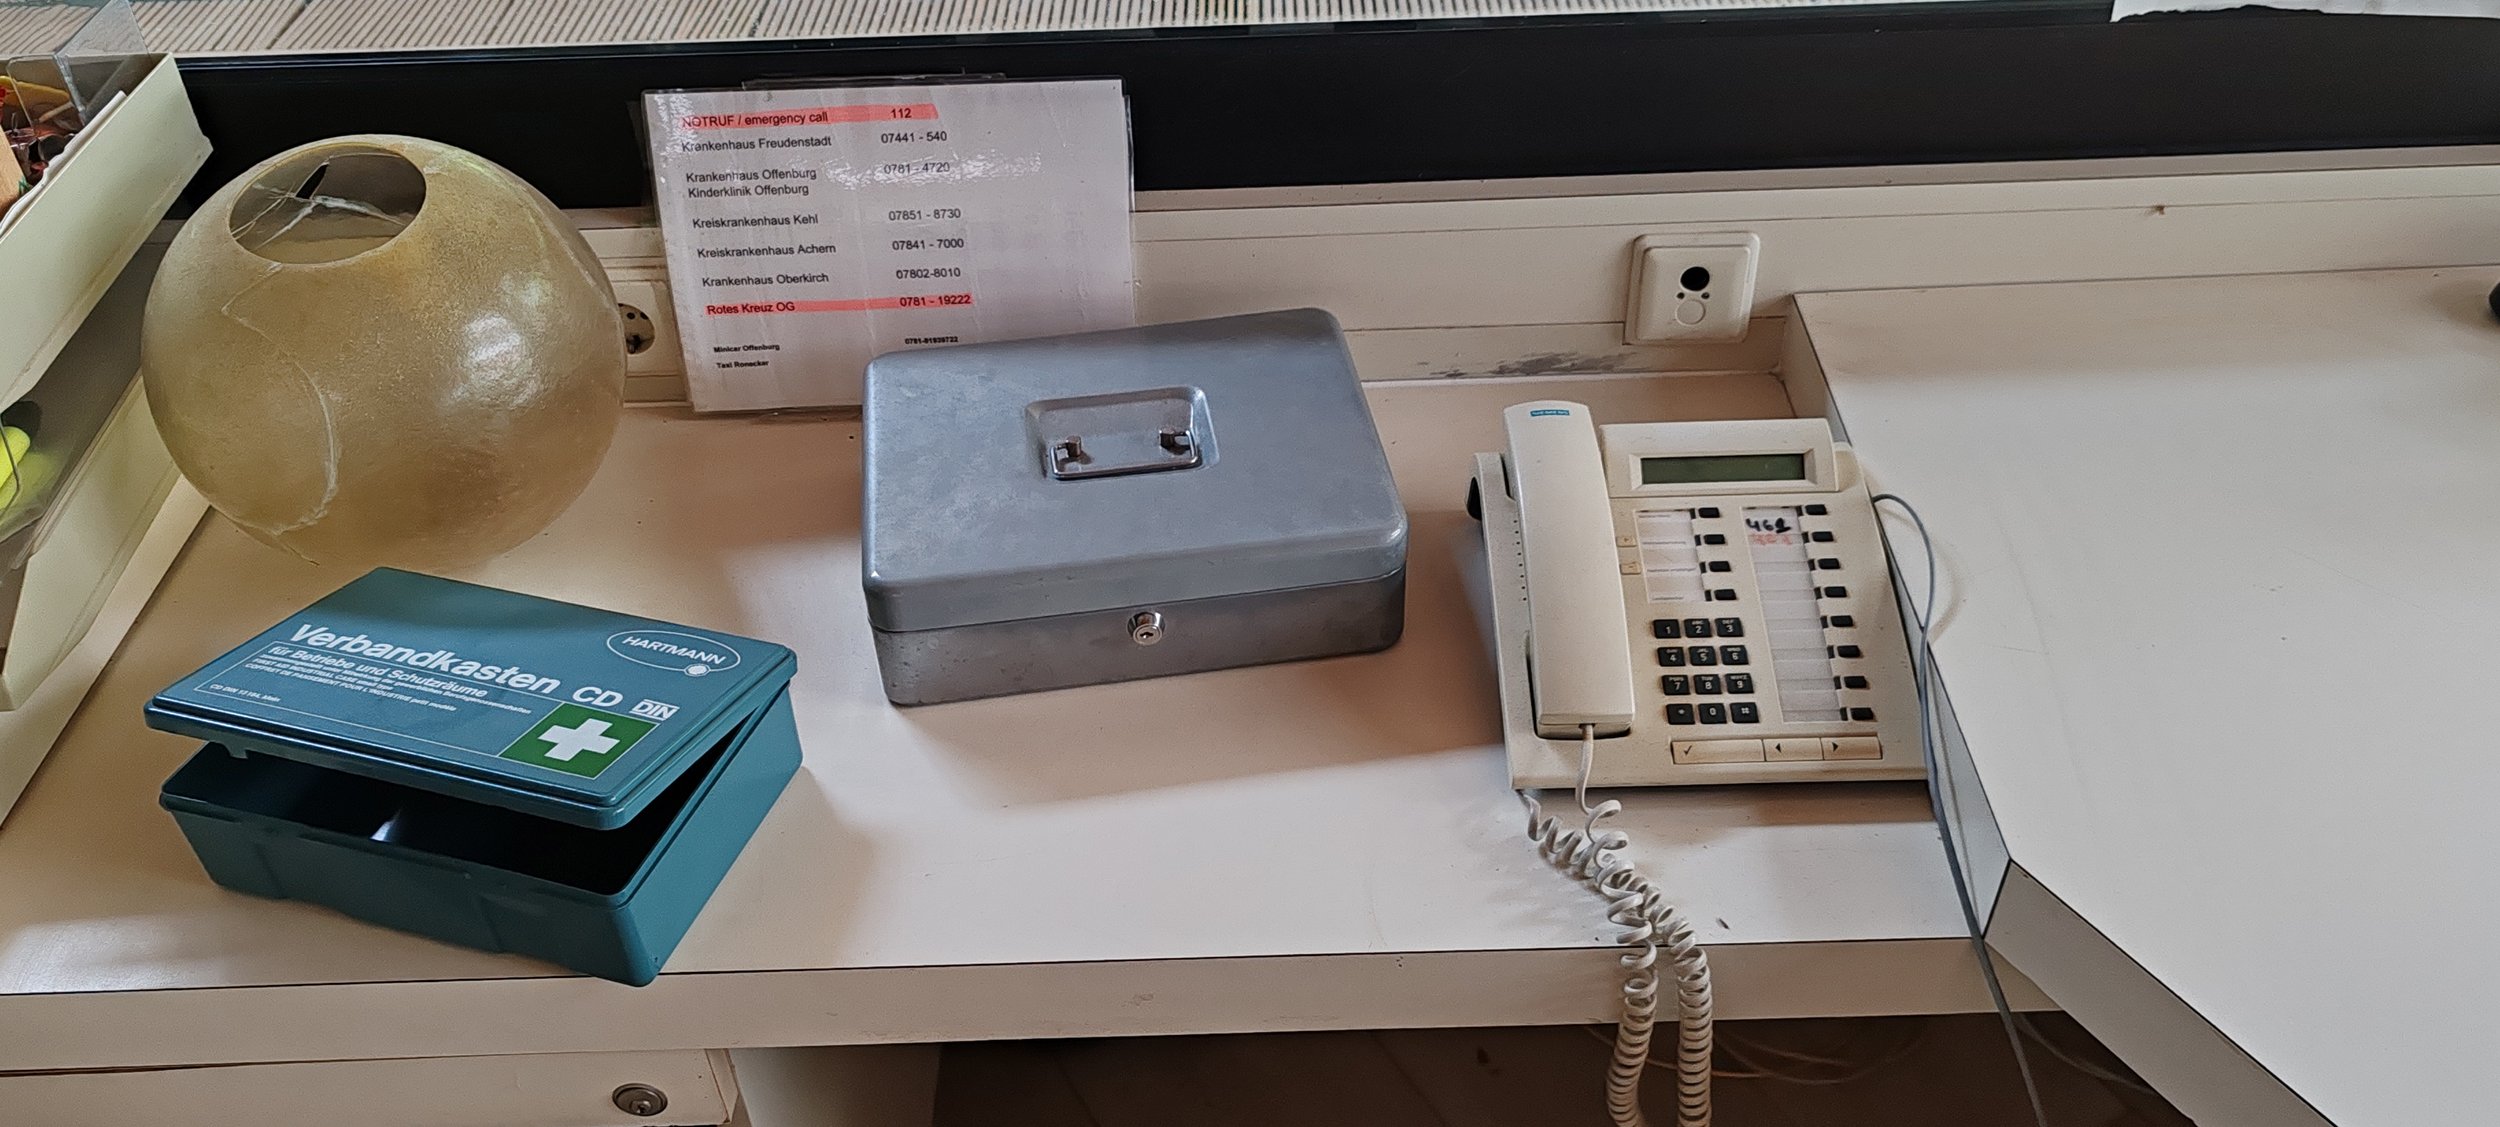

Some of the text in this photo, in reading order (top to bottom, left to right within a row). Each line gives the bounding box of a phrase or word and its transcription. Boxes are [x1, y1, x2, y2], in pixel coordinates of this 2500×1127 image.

[682, 115, 734, 128] NOTRUF
[744, 113, 806, 126] emergency
[808, 111, 828, 123] call
[891, 107, 912, 119] 112
[682, 140, 756, 152] Krankenhaus
[758, 136, 832, 149] Freudenstadt
[881, 132, 915, 144] 07441
[926, 131, 948, 142] 540
[686, 170, 759, 182] Krankenhaus
[762, 168, 817, 181] Offenburg
[883, 163, 911, 175] 0781
[922, 162, 951, 173] 4720
[688, 184, 809, 198] Kinderklinik Offenburg
[692, 216, 791, 229] Kreiskrankenhaus
[793, 214, 819, 225] Kehl
[888, 210, 922, 221] 07851
[933, 208, 961, 219] 8730
[697, 246, 795, 259] Kreiskrankenhaus
[797, 244, 837, 255] Achern
[892, 240, 925, 251] 07841
[936, 238, 965, 249] 7000
[702, 267, 961, 288] Krankenhaus Oberkirch 07802-8010
[707, 304, 739, 316] Rotes
[742, 303, 774, 313] Kreuz
[776, 301, 796, 312] OG
[899, 297, 926, 307] 0781
[938, 294, 971, 306] 19222
[743, 344, 780, 352] Offenburg
[1665, 626, 1671, 634] 1
[1695, 625, 1702, 634] 2
[1726, 624, 1734, 633] 3
[621, 635, 727, 665] HARTMANN
[1732, 652, 1739, 661] 6
[1700, 653, 1707, 662] 5
[268, 645, 488, 698] für Betriebe und Schutzräume
[288, 665, 335, 678] INDUSTRIAL
[290, 623, 624, 707] Verbandkasten CD
[1674, 682, 1681, 691] 7
[1705, 681, 1712, 690] 8
[1736, 680, 1744, 689] 9
[630, 700, 680, 721] DIN
[1709, 707, 1717, 716] 0
